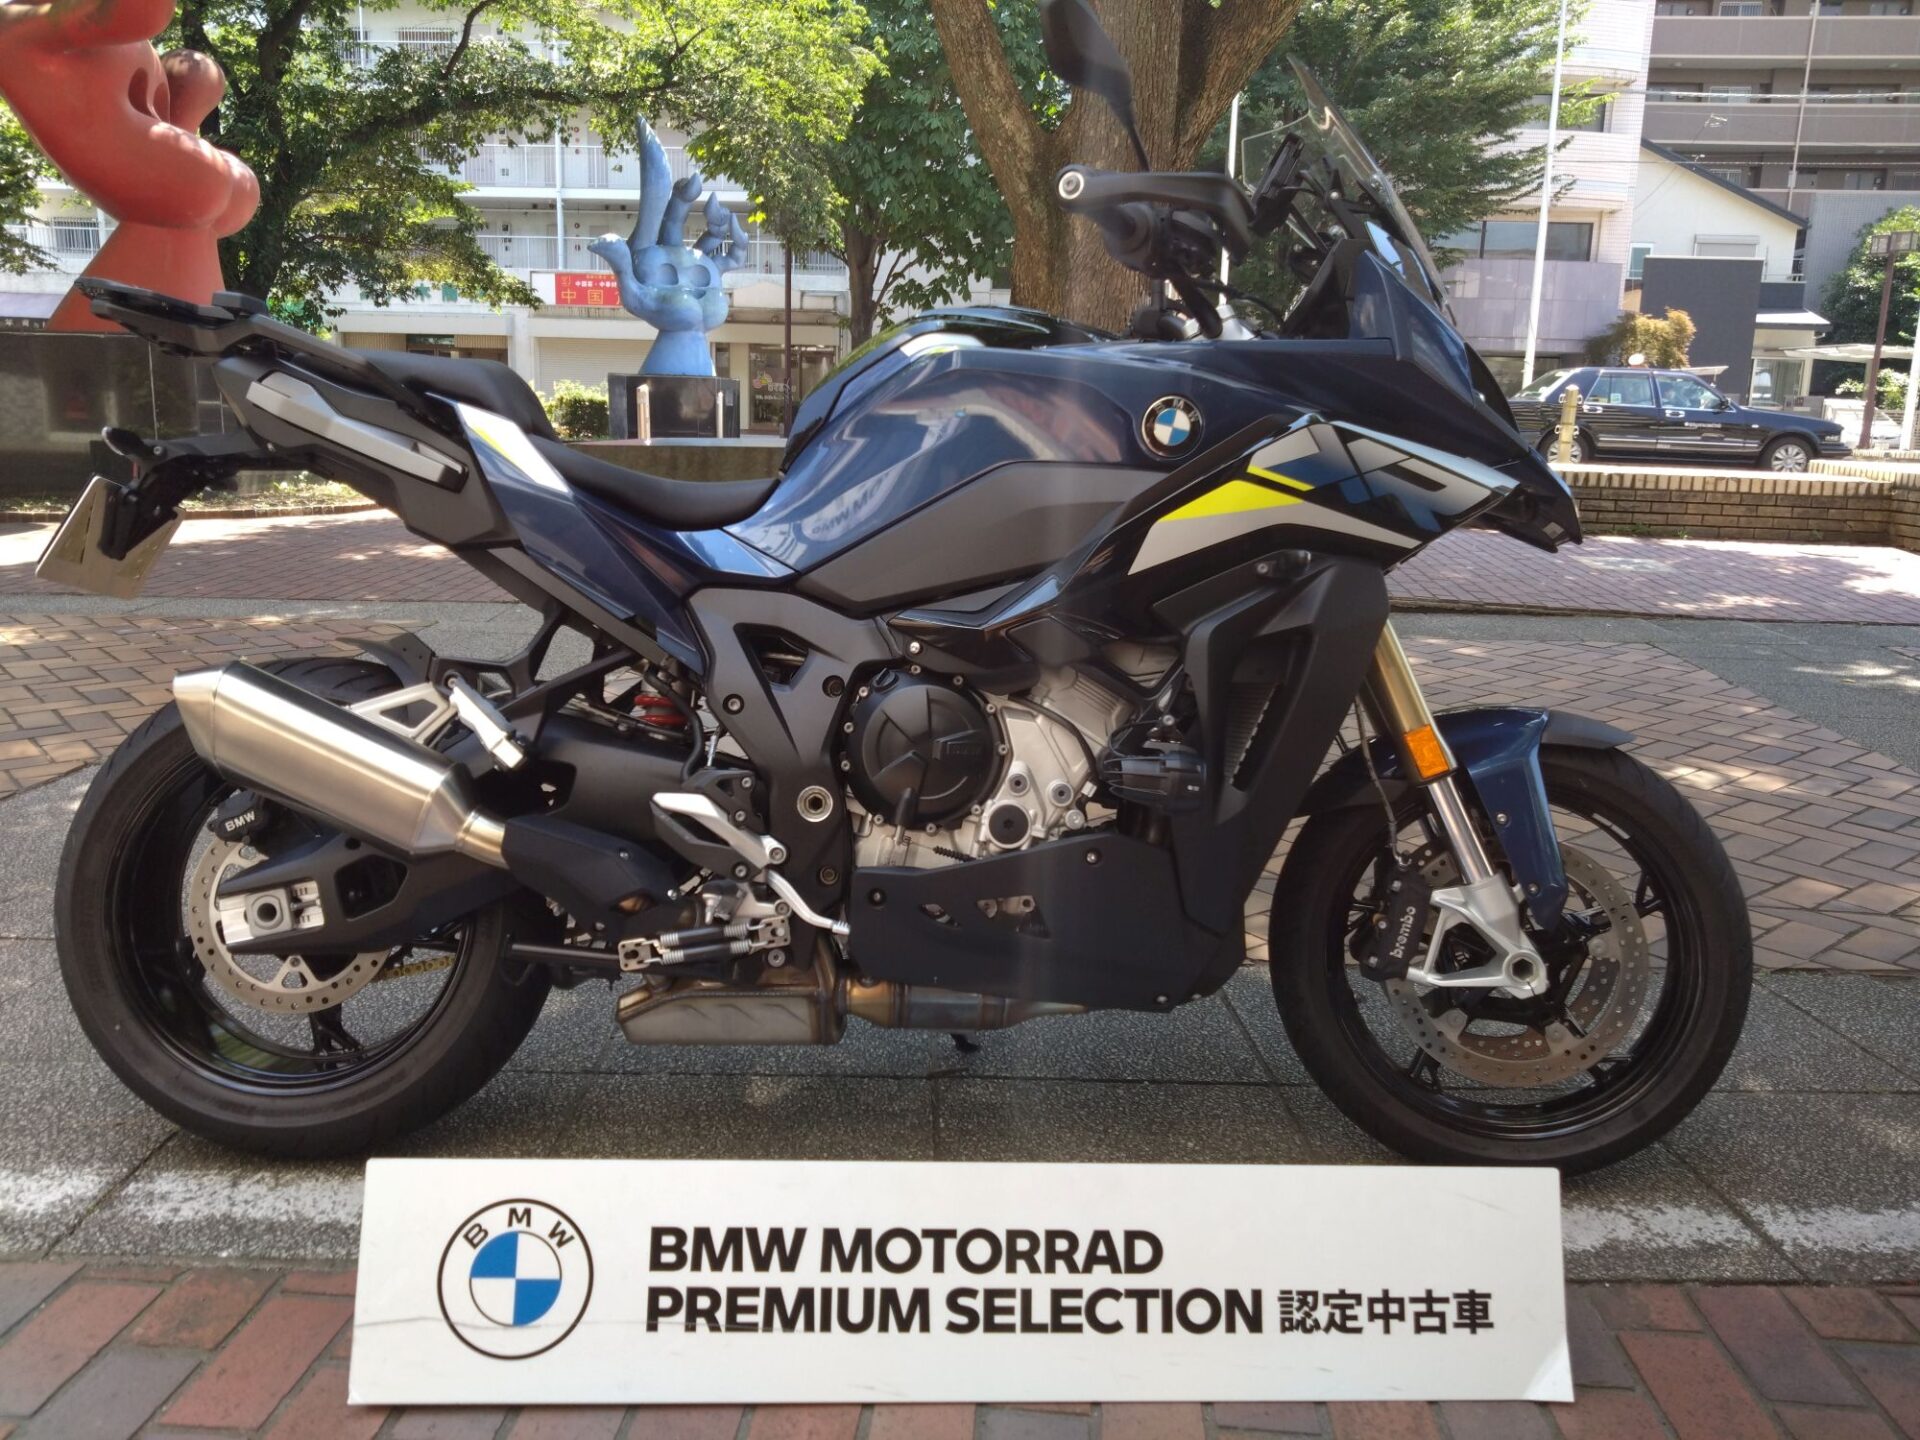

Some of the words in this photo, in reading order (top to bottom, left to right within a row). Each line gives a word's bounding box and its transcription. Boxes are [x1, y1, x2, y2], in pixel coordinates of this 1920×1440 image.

[1155, 398, 1199, 422] BMW
[225, 811, 255, 832] BMW
[1389, 906, 1416, 959] brembo
[463, 1207, 575, 1249] BMW
[649, 1226, 807, 1272] BMW
[820, 1228, 1164, 1275] MOTORRAD
[646, 1286, 931, 1333] PREMIUM
[945, 1287, 1263, 1335] SELECTION
[1278, 1289, 1494, 1335] 認定中古車
